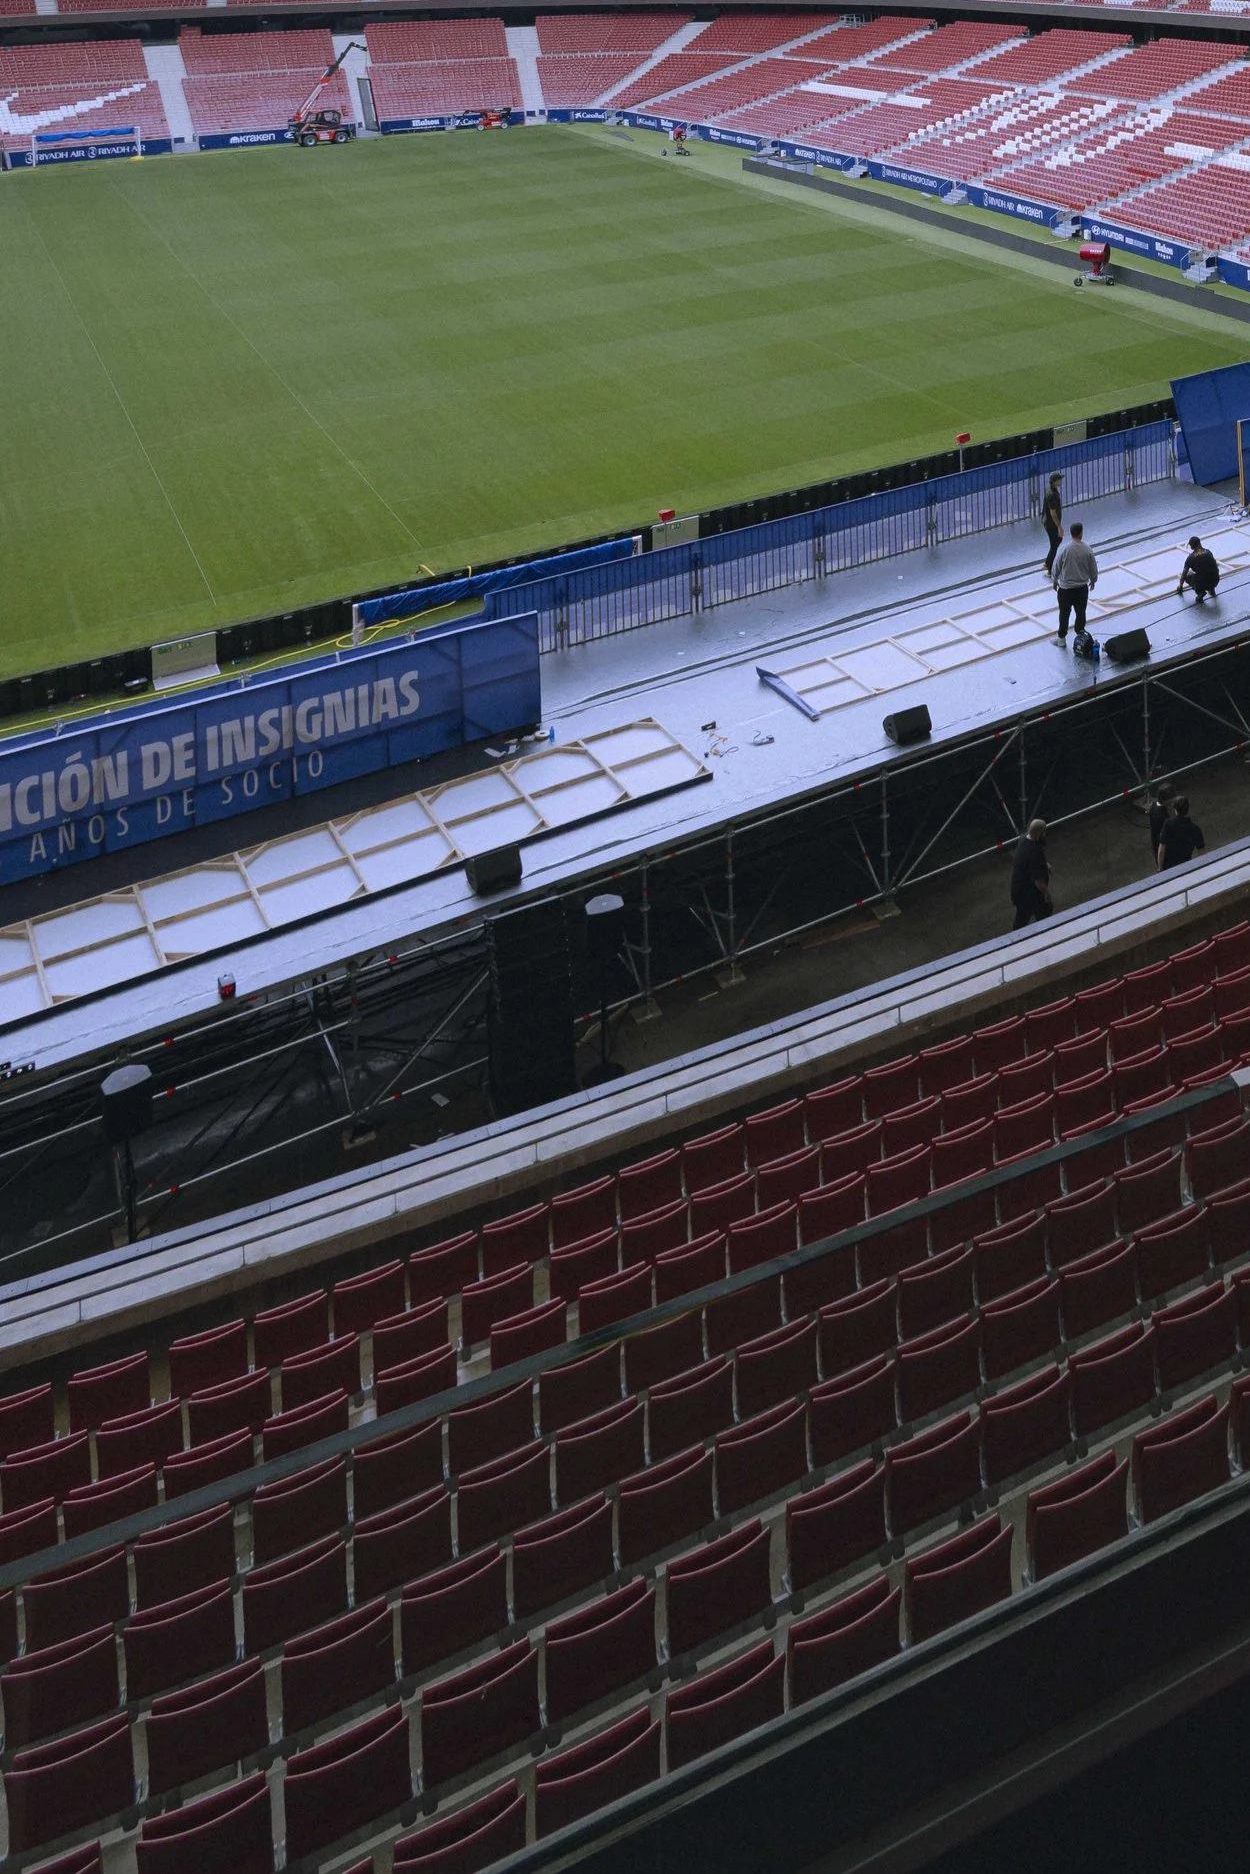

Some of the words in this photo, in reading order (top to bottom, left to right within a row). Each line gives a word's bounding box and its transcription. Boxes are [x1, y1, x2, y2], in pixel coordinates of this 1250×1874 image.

[35, 150, 69, 162] RIYADH
[69, 149, 85, 159] AIR
[98, 145, 131, 156] RIYADH
[131, 144, 146, 153] AR
[1100, 227, 1125, 243] HYUNDAI
[140, 731, 197, 790] DE
[205, 669, 420, 771] INSIGNIAS
[29, 806, 129, 863] AÑOS
[156, 787, 196, 824] DE
[221, 749, 324, 805] SOCIO
